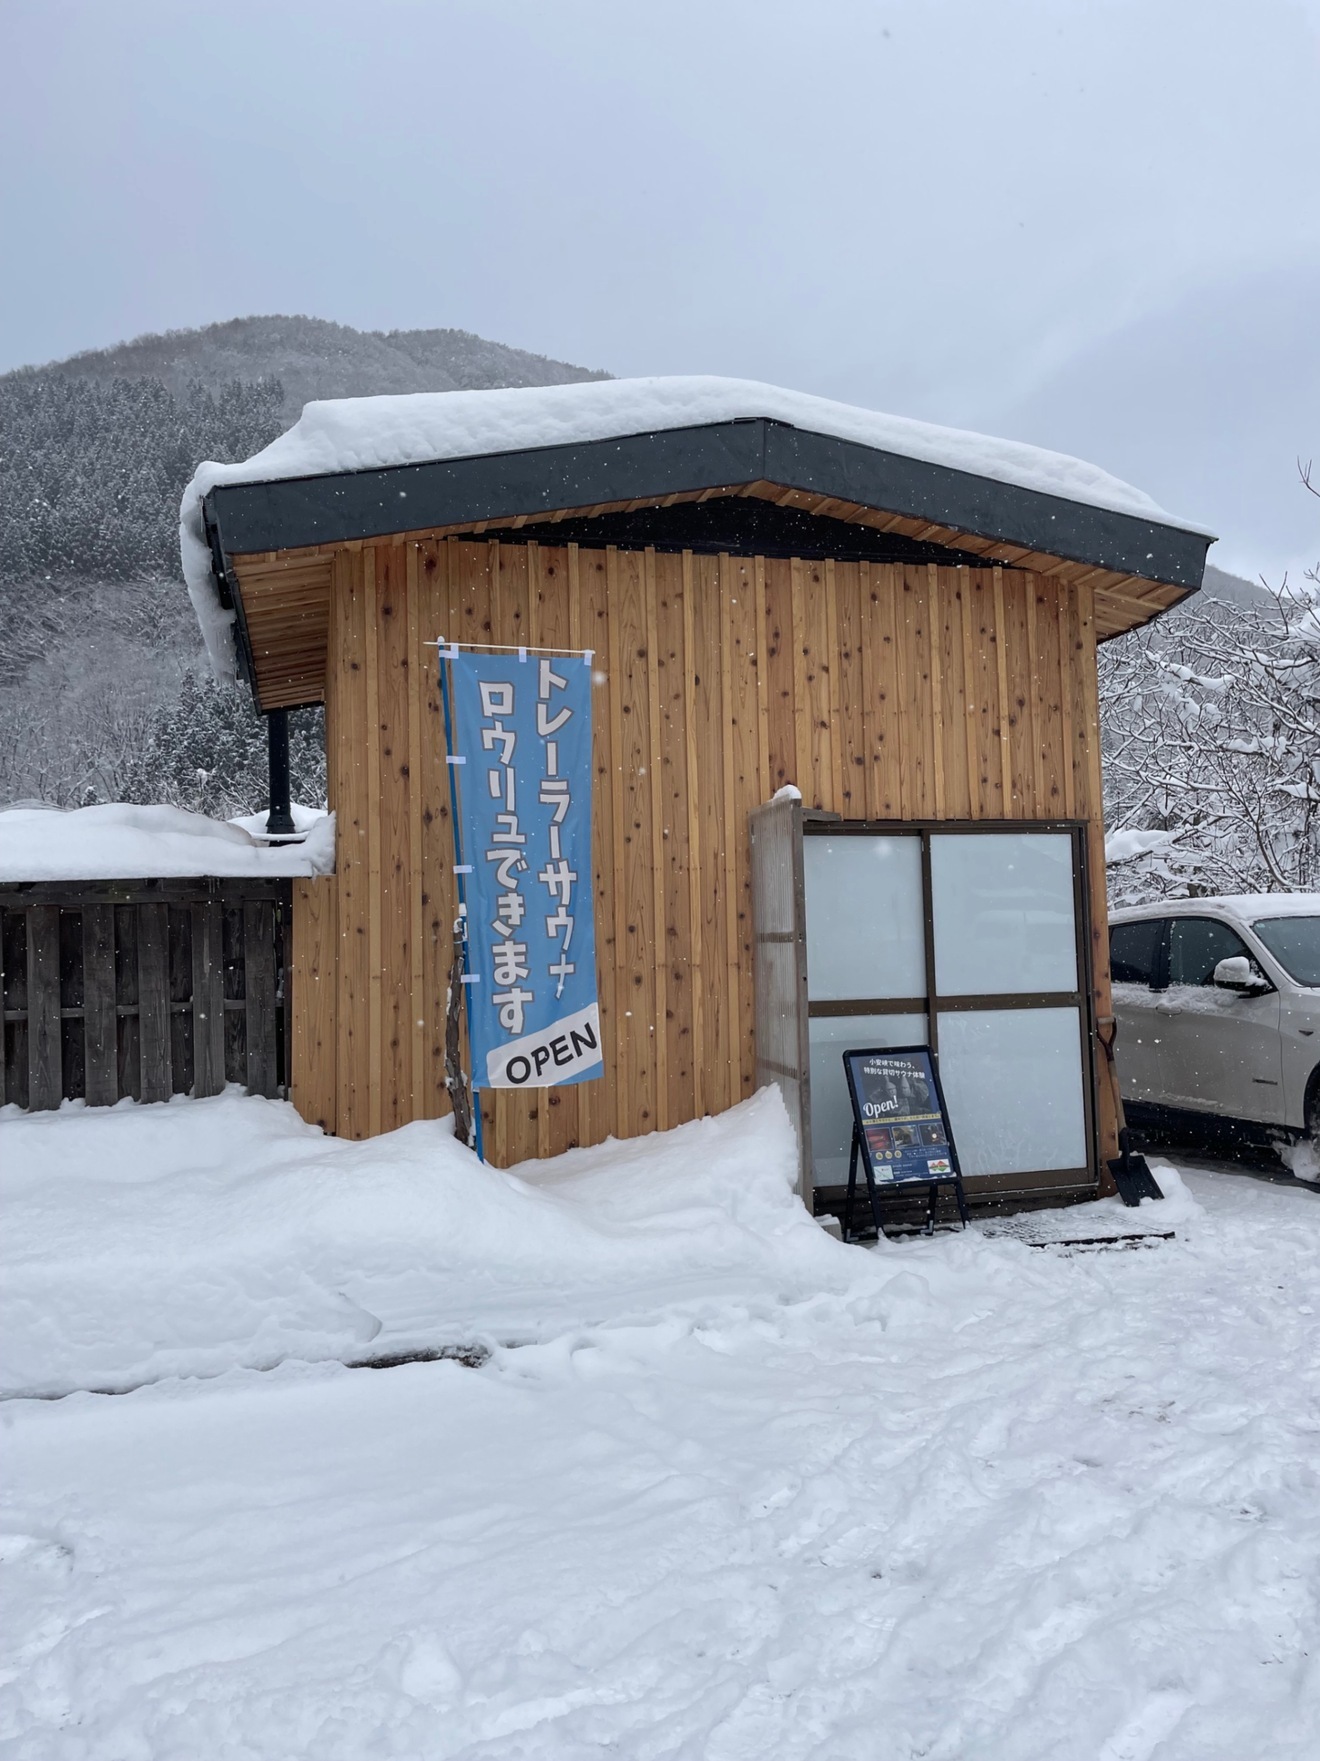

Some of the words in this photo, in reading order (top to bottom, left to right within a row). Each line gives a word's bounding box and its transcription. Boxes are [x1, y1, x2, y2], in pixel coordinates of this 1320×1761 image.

[478, 680, 534, 1036] ロウリュできます
[537, 658, 578, 1000] トレーラーサウナ
[506, 1021, 598, 1085] OPEN
[863, 1095, 899, 1118] Open!
